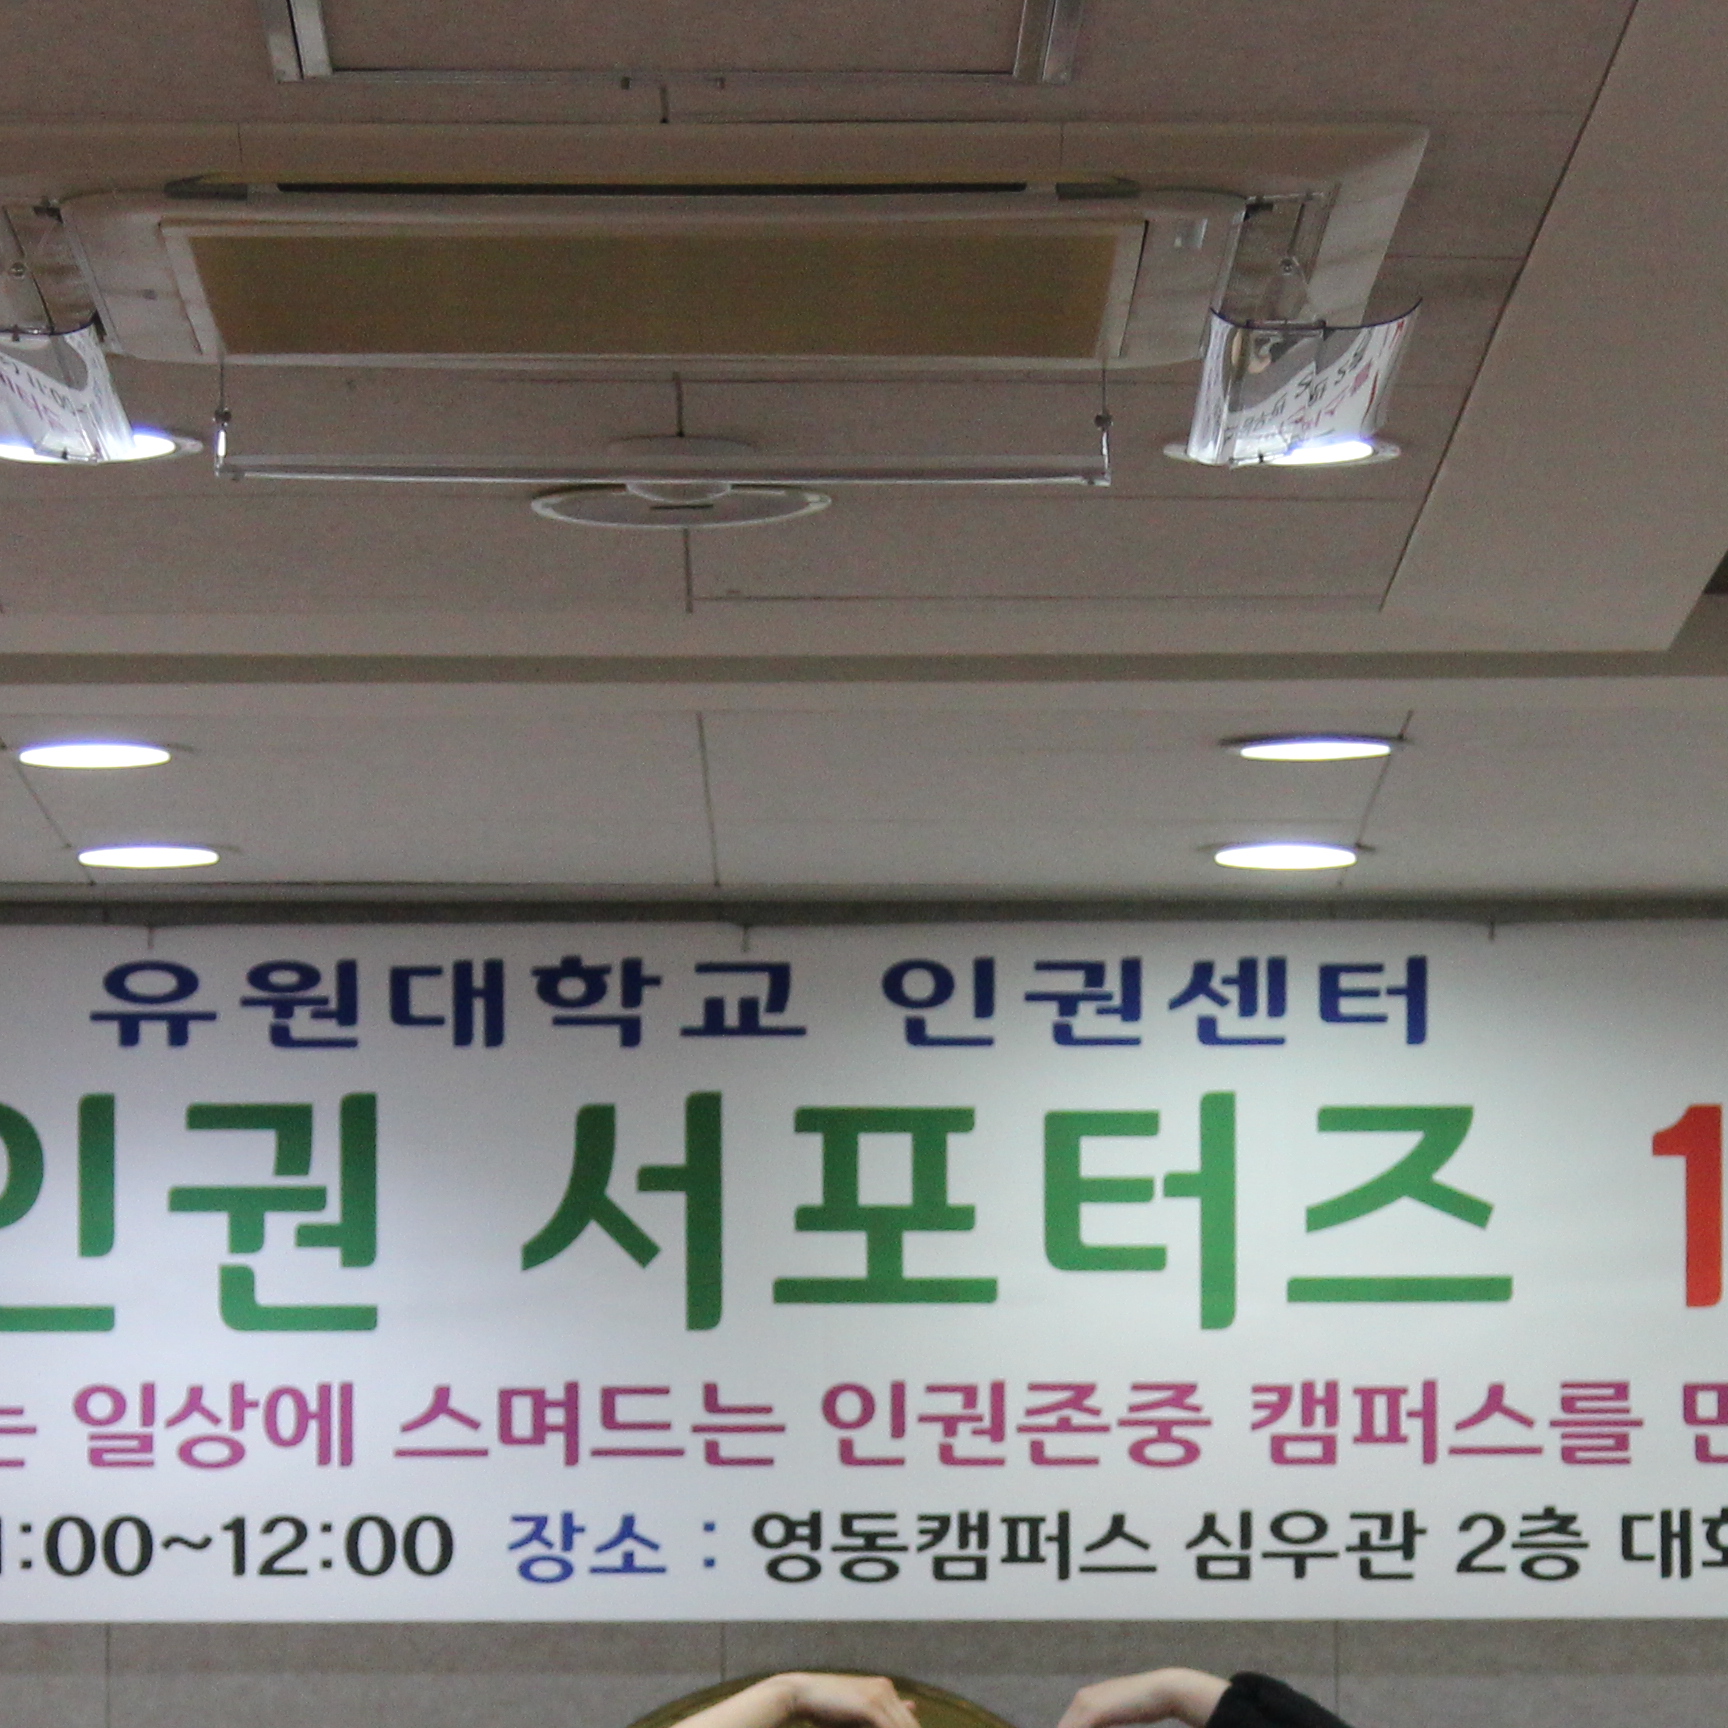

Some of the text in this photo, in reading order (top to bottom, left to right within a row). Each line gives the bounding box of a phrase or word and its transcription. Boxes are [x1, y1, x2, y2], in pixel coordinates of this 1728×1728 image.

[89, 953, 1433, 1051] 유원대학교 인권센터
[520, 1090, 1513, 1332] 서포터즈
[74, 1383, 353, 1469] 일상에
[395, 1381, 786, 1467] 스며드는
[821, 1381, 1211, 1468] 인권존중
[1251, 1380, 1643, 1466] 캠퍼스를
[751, 1510, 1157, 1584] 영동캠퍼스
[1185, 1509, 1427, 1582] 심우관
[1456, 1505, 1589, 1582] 2층
